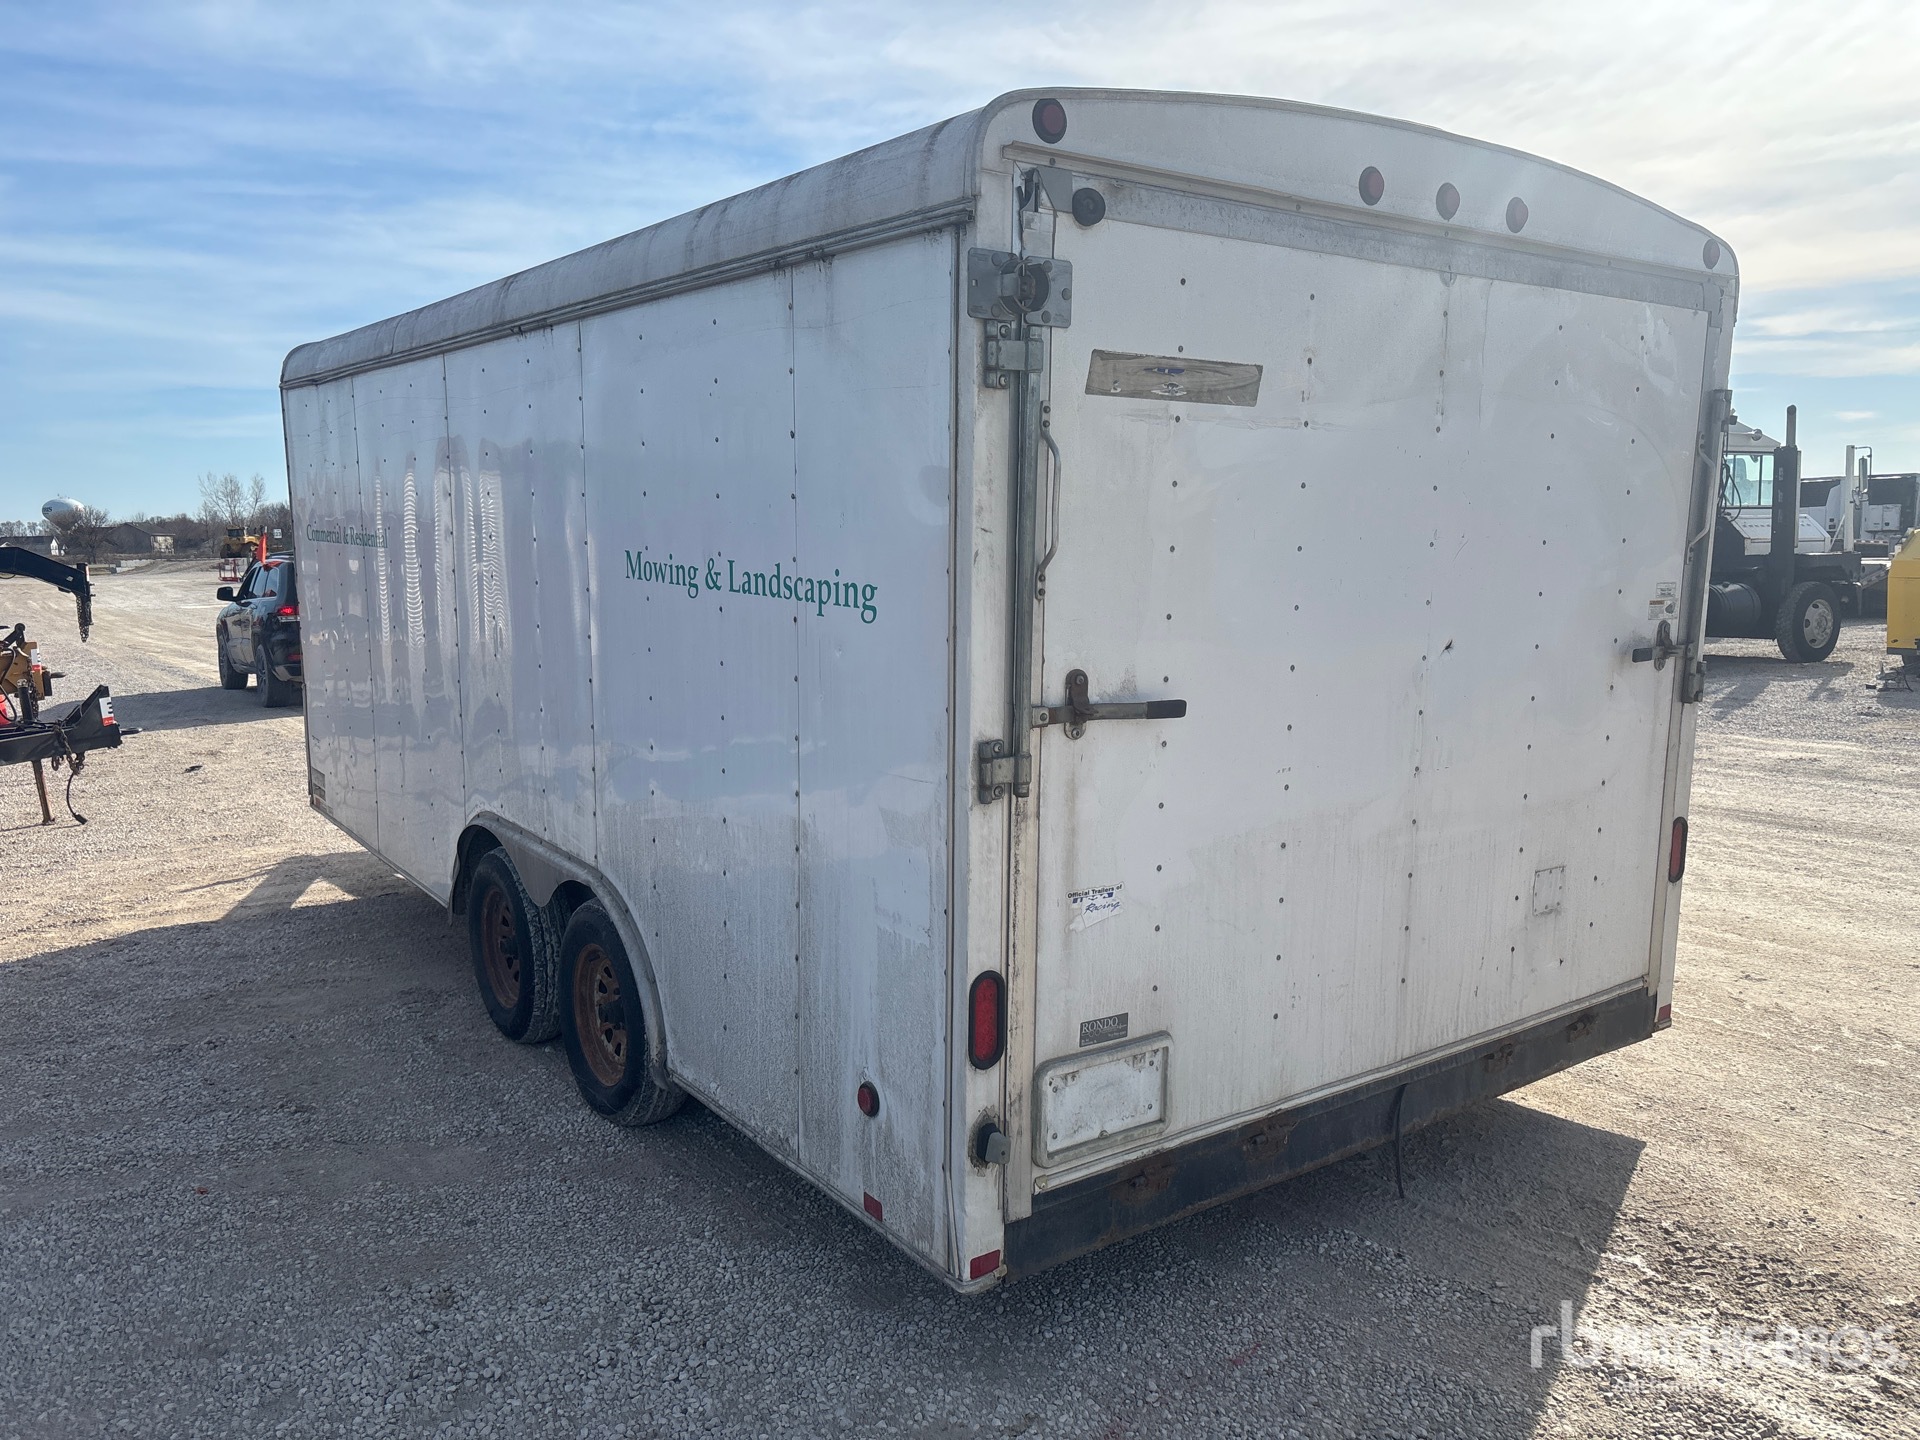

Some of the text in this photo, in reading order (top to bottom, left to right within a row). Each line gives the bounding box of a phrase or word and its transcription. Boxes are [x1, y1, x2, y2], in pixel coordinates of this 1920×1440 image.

[307, 524, 388, 548] Commercial & Residential
[624, 549, 878, 624] Mowing & Landscaping
[1067, 890, 1090, 899] Official
[1091, 887, 1115, 895] Trailers
[1083, 901, 1120, 915] Racing
[1082, 1016, 1119, 1034] RONDO
